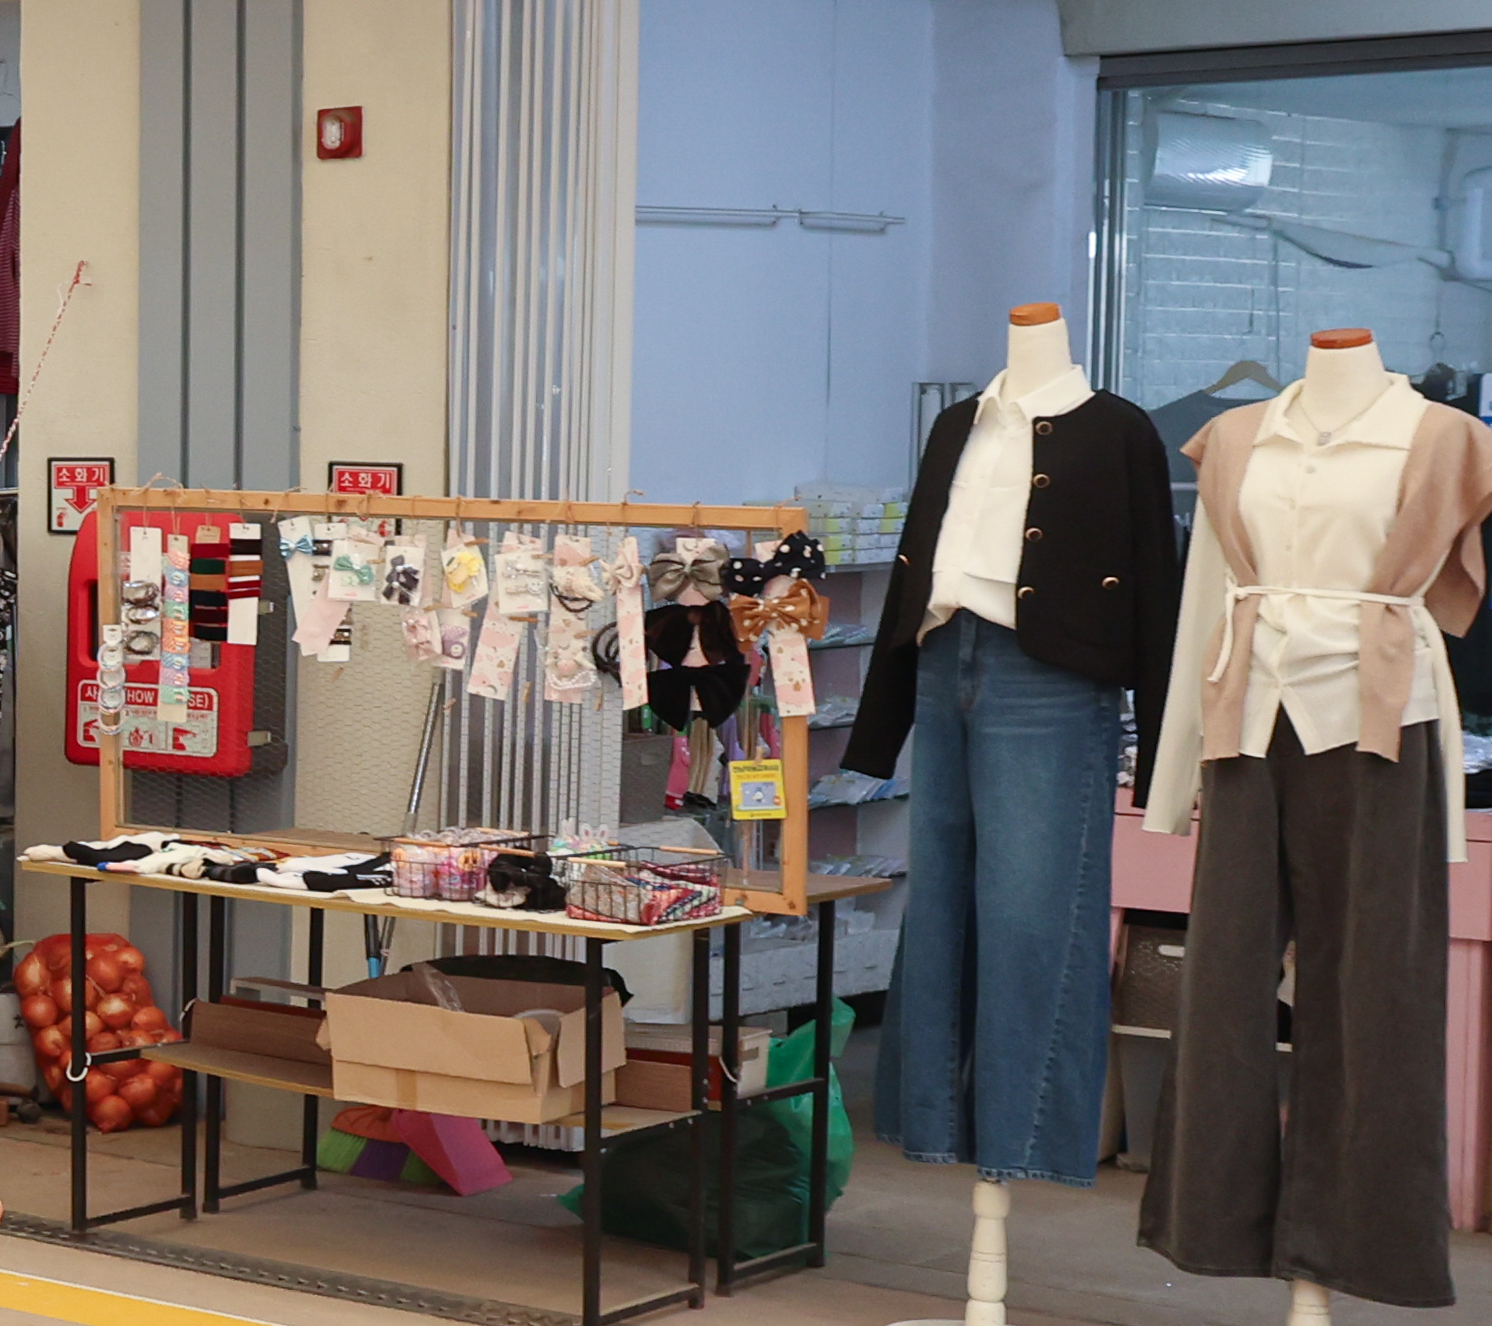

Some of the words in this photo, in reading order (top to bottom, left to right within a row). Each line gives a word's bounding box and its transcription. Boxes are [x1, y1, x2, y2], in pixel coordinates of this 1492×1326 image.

[58, 468, 106, 483] 소화기
[340, 472, 391, 488] 소화기
[188, 694, 210, 708] SE)
